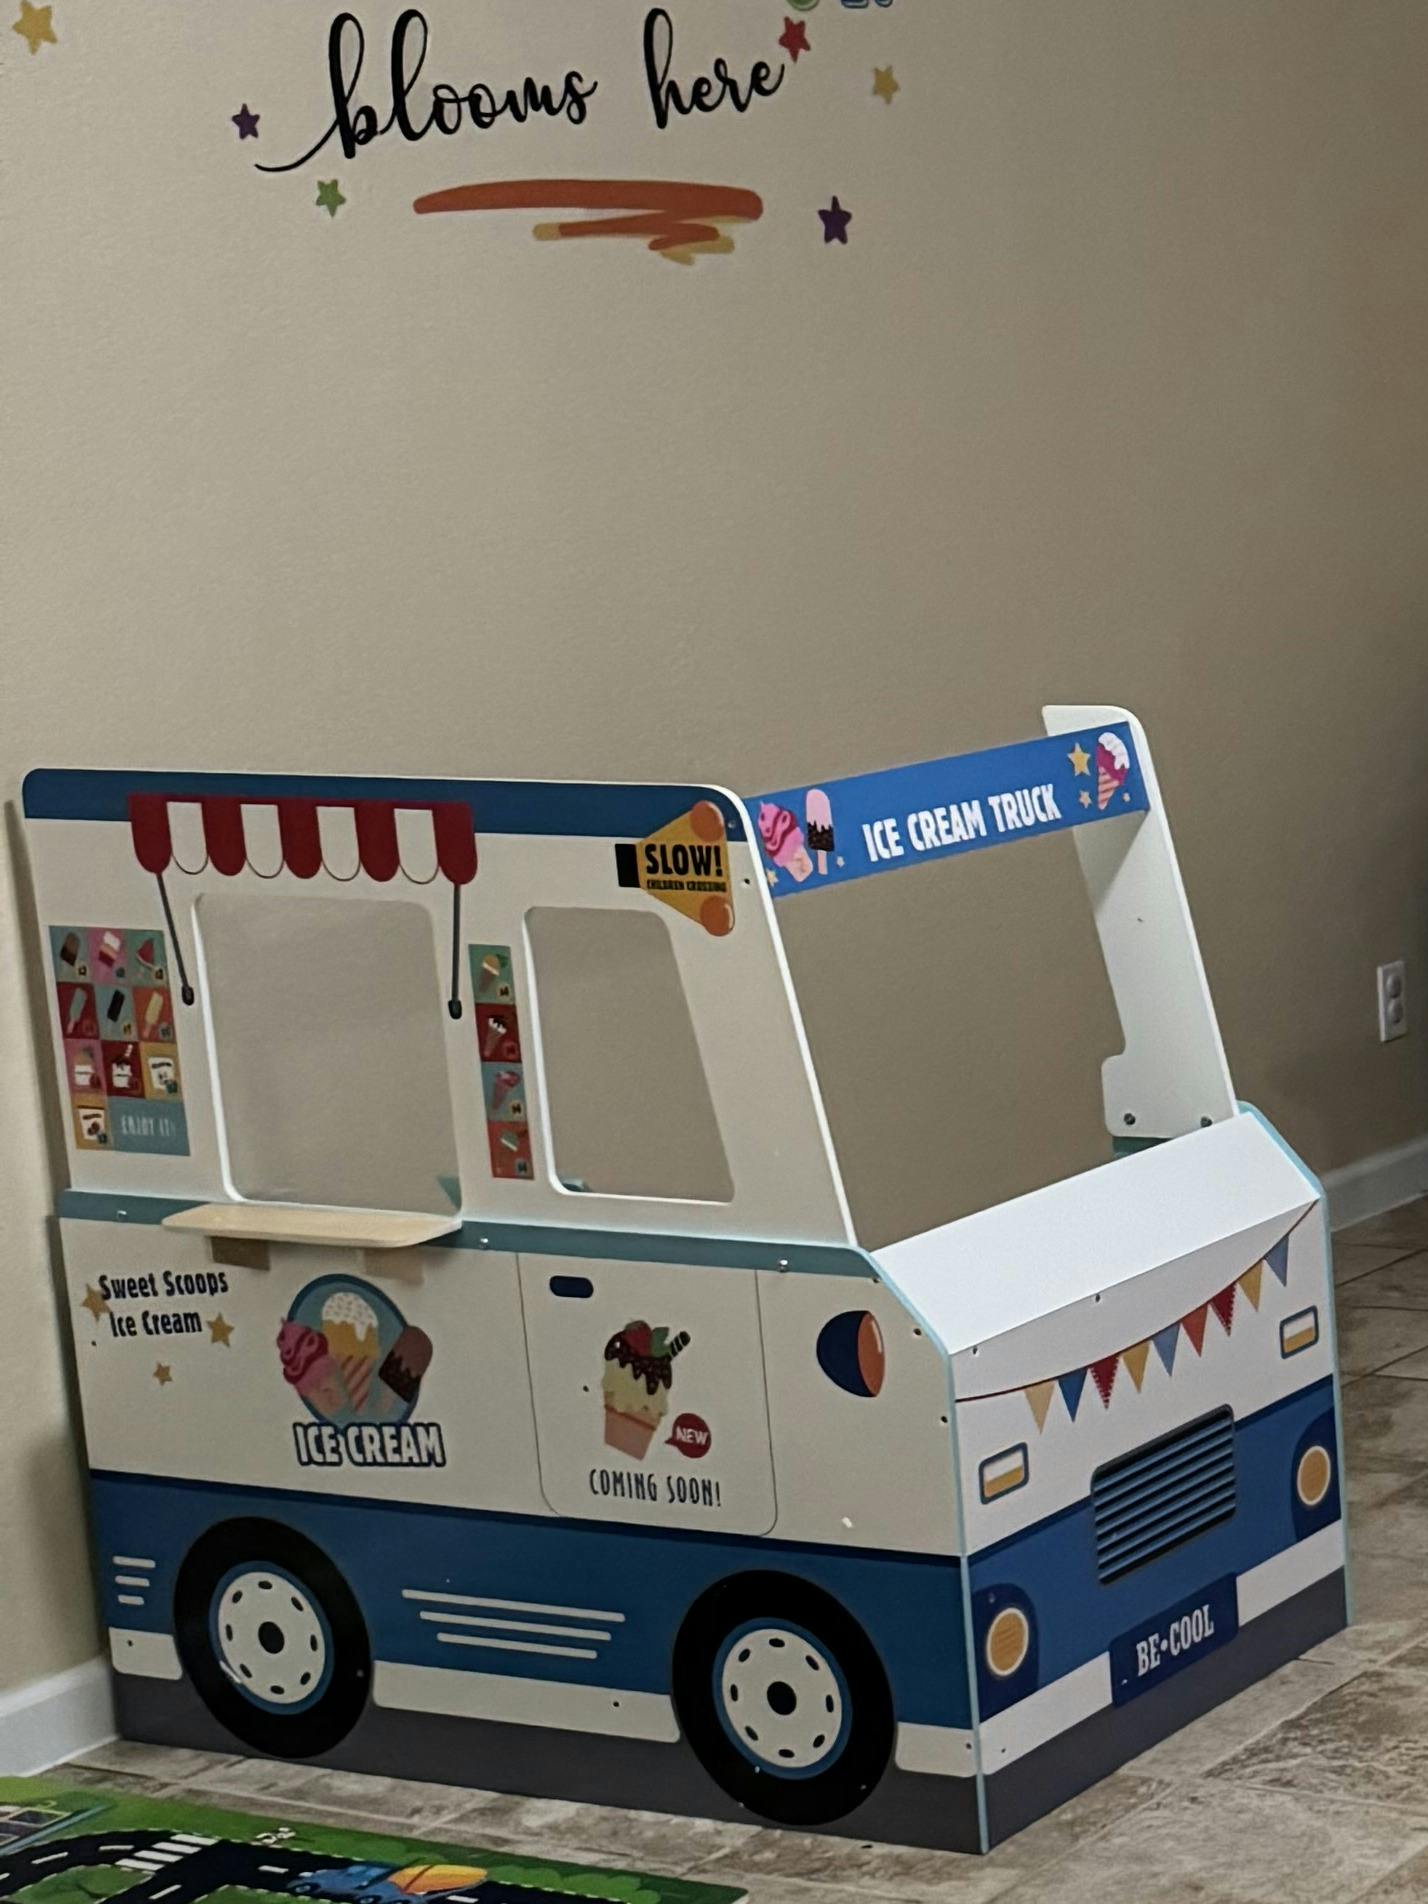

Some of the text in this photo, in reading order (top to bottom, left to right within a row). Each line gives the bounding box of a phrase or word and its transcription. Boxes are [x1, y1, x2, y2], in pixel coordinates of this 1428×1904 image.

[254, 7, 786, 173] blooms here
[861, 783, 1063, 863] ICE CREAM TRUCK
[644, 843, 723, 876] SLOW!
[98, 1270, 229, 1300] Sweet Scoops
[109, 1310, 203, 1338] Ice Cream
[293, 1423, 446, 1467] ICE CREAM
[675, 1426, 710, 1445] NEW
[589, 1468, 722, 1507] COMING SOON!
